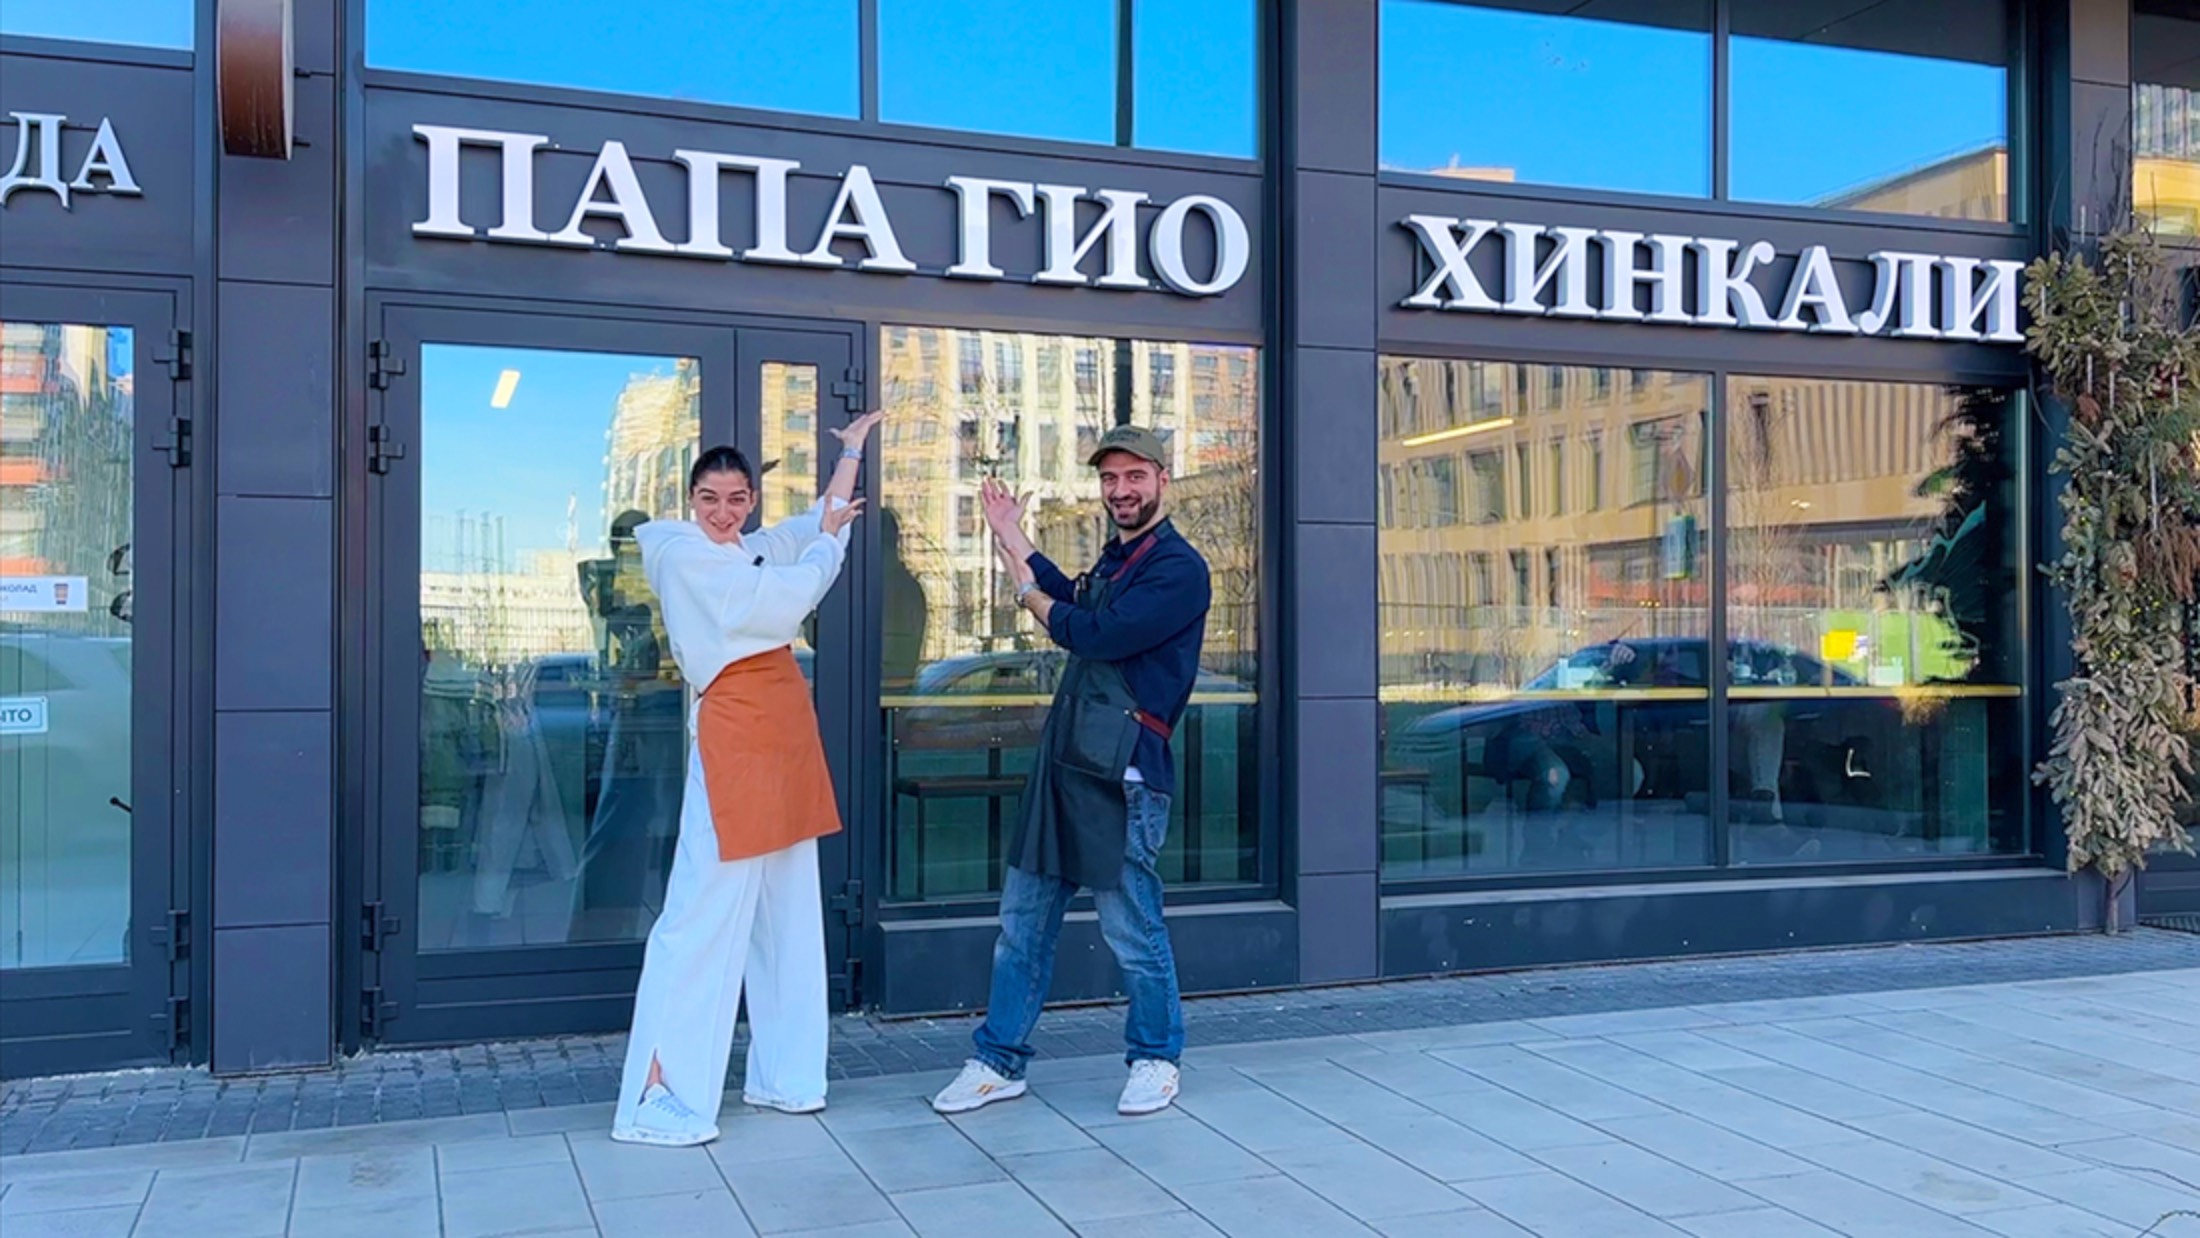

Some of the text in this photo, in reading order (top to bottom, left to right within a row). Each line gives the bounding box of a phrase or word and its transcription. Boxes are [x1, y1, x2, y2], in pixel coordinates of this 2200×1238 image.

[0, 111, 141, 208] ДА
[411, 124, 1250, 295] ПАПА ГИО
[1400, 214, 2025, 342] ХИНКАЛИ
